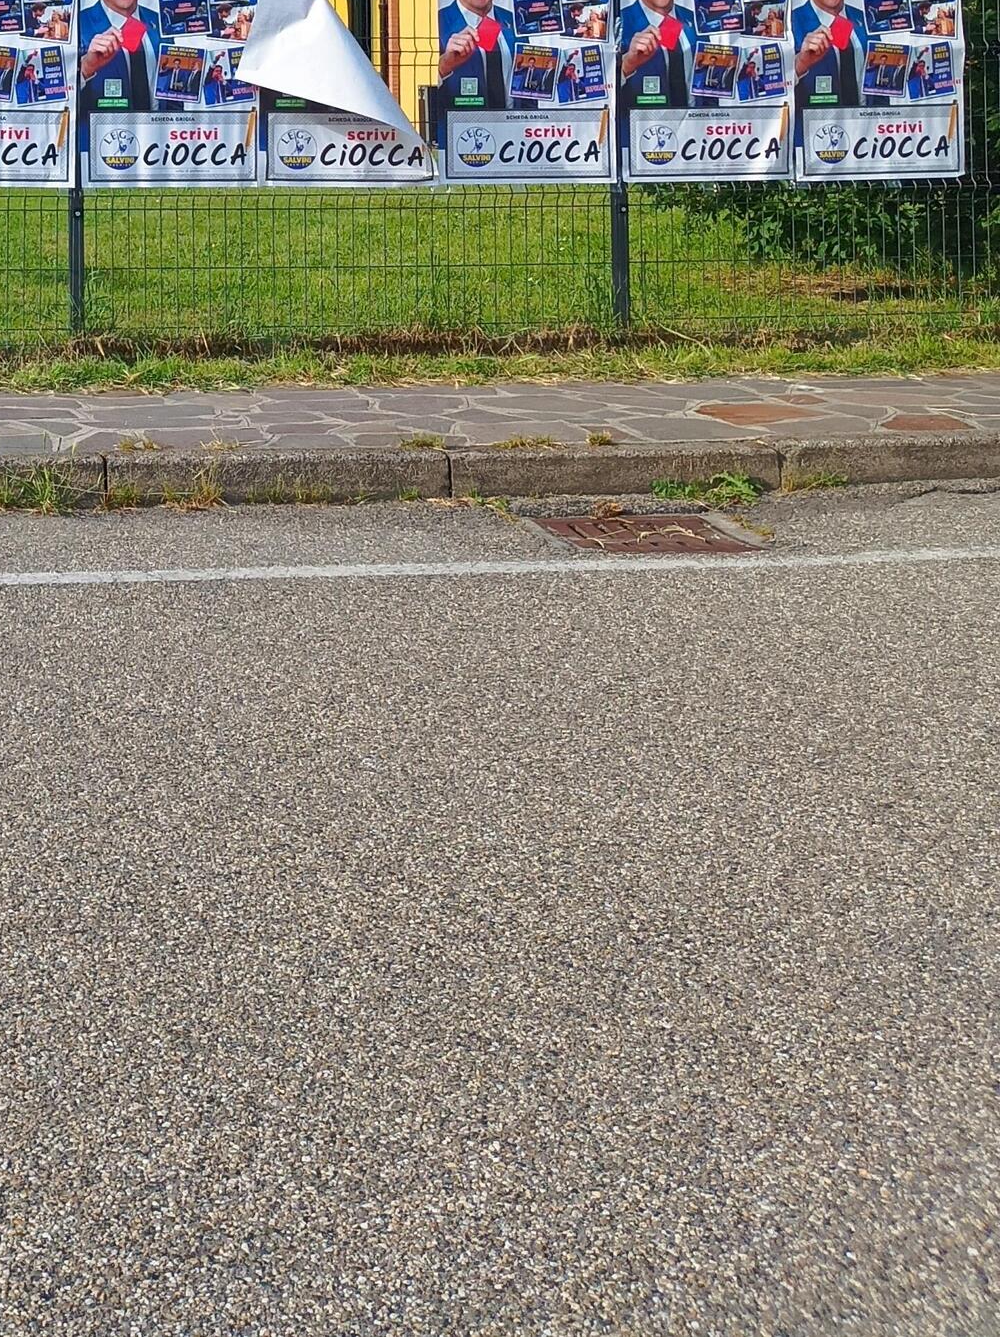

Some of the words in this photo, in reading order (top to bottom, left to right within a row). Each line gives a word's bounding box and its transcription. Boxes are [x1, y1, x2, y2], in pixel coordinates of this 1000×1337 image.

[170, 128, 219, 140] scrivi
[525, 126, 572, 138] scrivi
[706, 123, 753, 135] scrivi
[878, 122, 923, 134] scrivi
[103, 132, 135, 145] LEGA
[347, 128, 396, 141] scrivi
[460, 130, 490, 143] LEGA
[642, 128, 673, 141] LEGA
[105, 156, 135, 165] SALVINI
[462, 154, 491, 162] SALVINI
[645, 152, 674, 160] SALVINI
